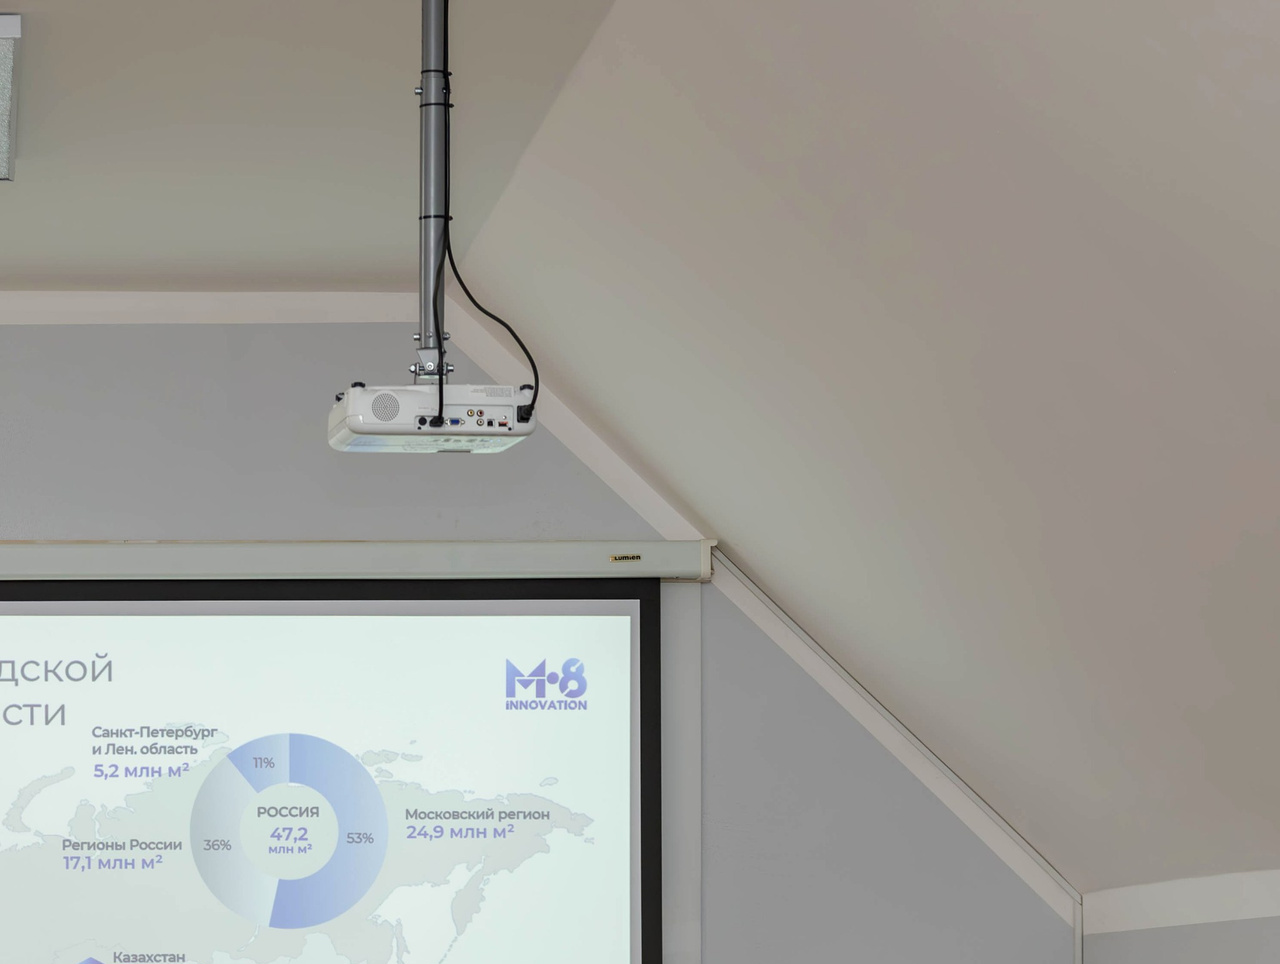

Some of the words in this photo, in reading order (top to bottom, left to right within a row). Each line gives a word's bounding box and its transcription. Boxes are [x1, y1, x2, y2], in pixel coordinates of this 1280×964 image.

[91, 725, 219, 742] Санкт-Петербург
[91, 745, 102, 755] и
[104, 743, 138, 757] Лен.
[140, 742, 198, 756] область
[253, 757, 275, 769] 11%
[93, 763, 120, 781] 5,2
[124, 766, 163, 778] млн
[256, 806, 320, 818] РОССИЯ
[405, 808, 494, 821] Московский
[498, 809, 551, 823] регион
[269, 827, 308, 843] 47,2
[346, 831, 375, 845] 53%
[406, 825, 445, 842] 24,9
[450, 827, 489, 839] млн
[62, 838, 126, 853] Регионы
[129, 838, 183, 852] России
[203, 838, 232, 852] 36%
[268, 845, 294, 853] млн
[63, 855, 93, 872] 17,1
[97, 857, 136, 870] млн
[113, 952, 186, 964] Казахстан
